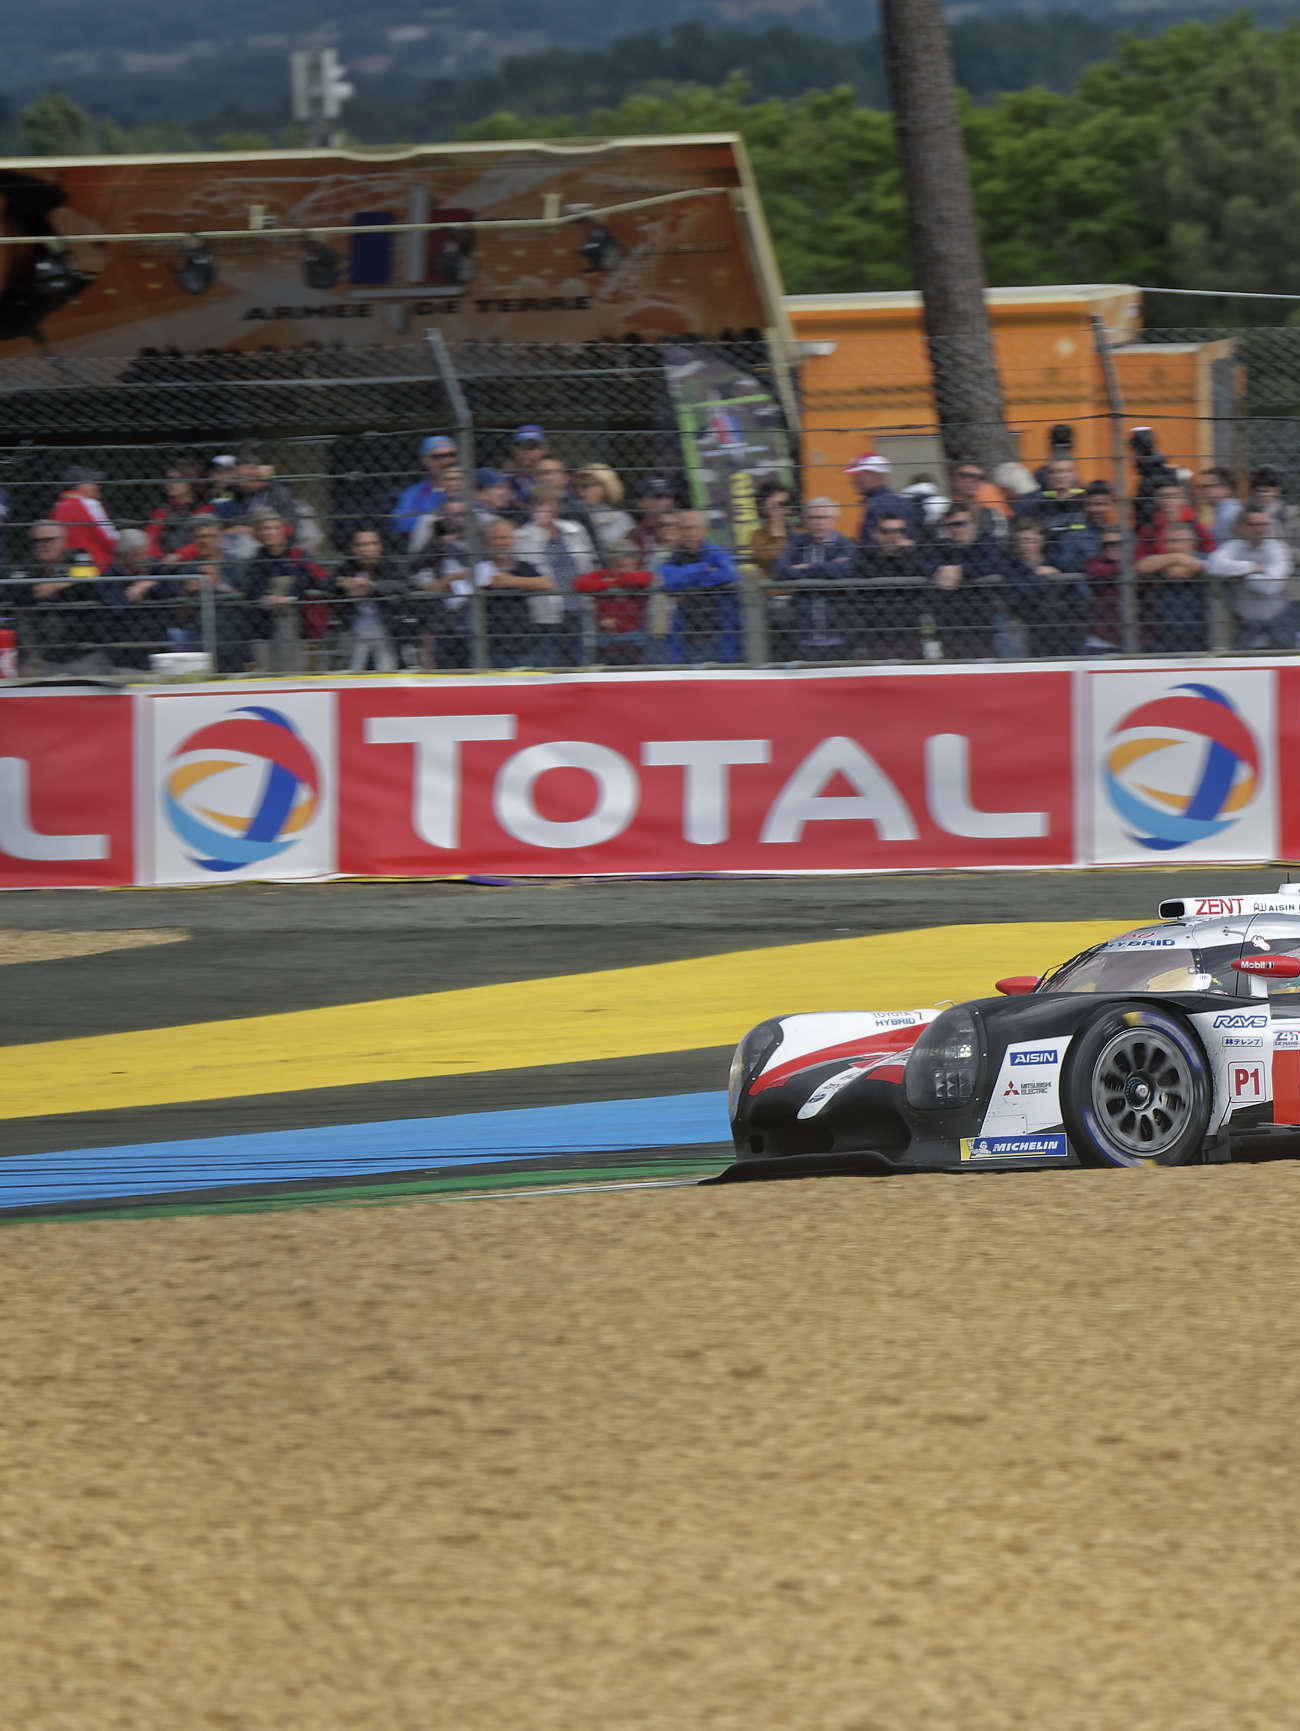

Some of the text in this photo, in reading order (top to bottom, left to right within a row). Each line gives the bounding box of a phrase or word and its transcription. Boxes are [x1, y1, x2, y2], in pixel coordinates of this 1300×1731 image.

[417, 300, 459, 316] DE
[476, 296, 591, 313] TERRE
[366, 714, 1049, 849] TOTAL
[1195, 899, 1244, 915] ZENT
[1268, 904, 1295, 912] AISIN
[1240, 960, 1265, 969] Mobil
[875, 1017, 916, 1027] HYBRID
[1213, 1015, 1268, 1028] RAYS
[1014, 1052, 1055, 1064] AISIN
[1234, 1068, 1260, 1096] P1
[992, 1140, 1059, 1152] MICHELIN
